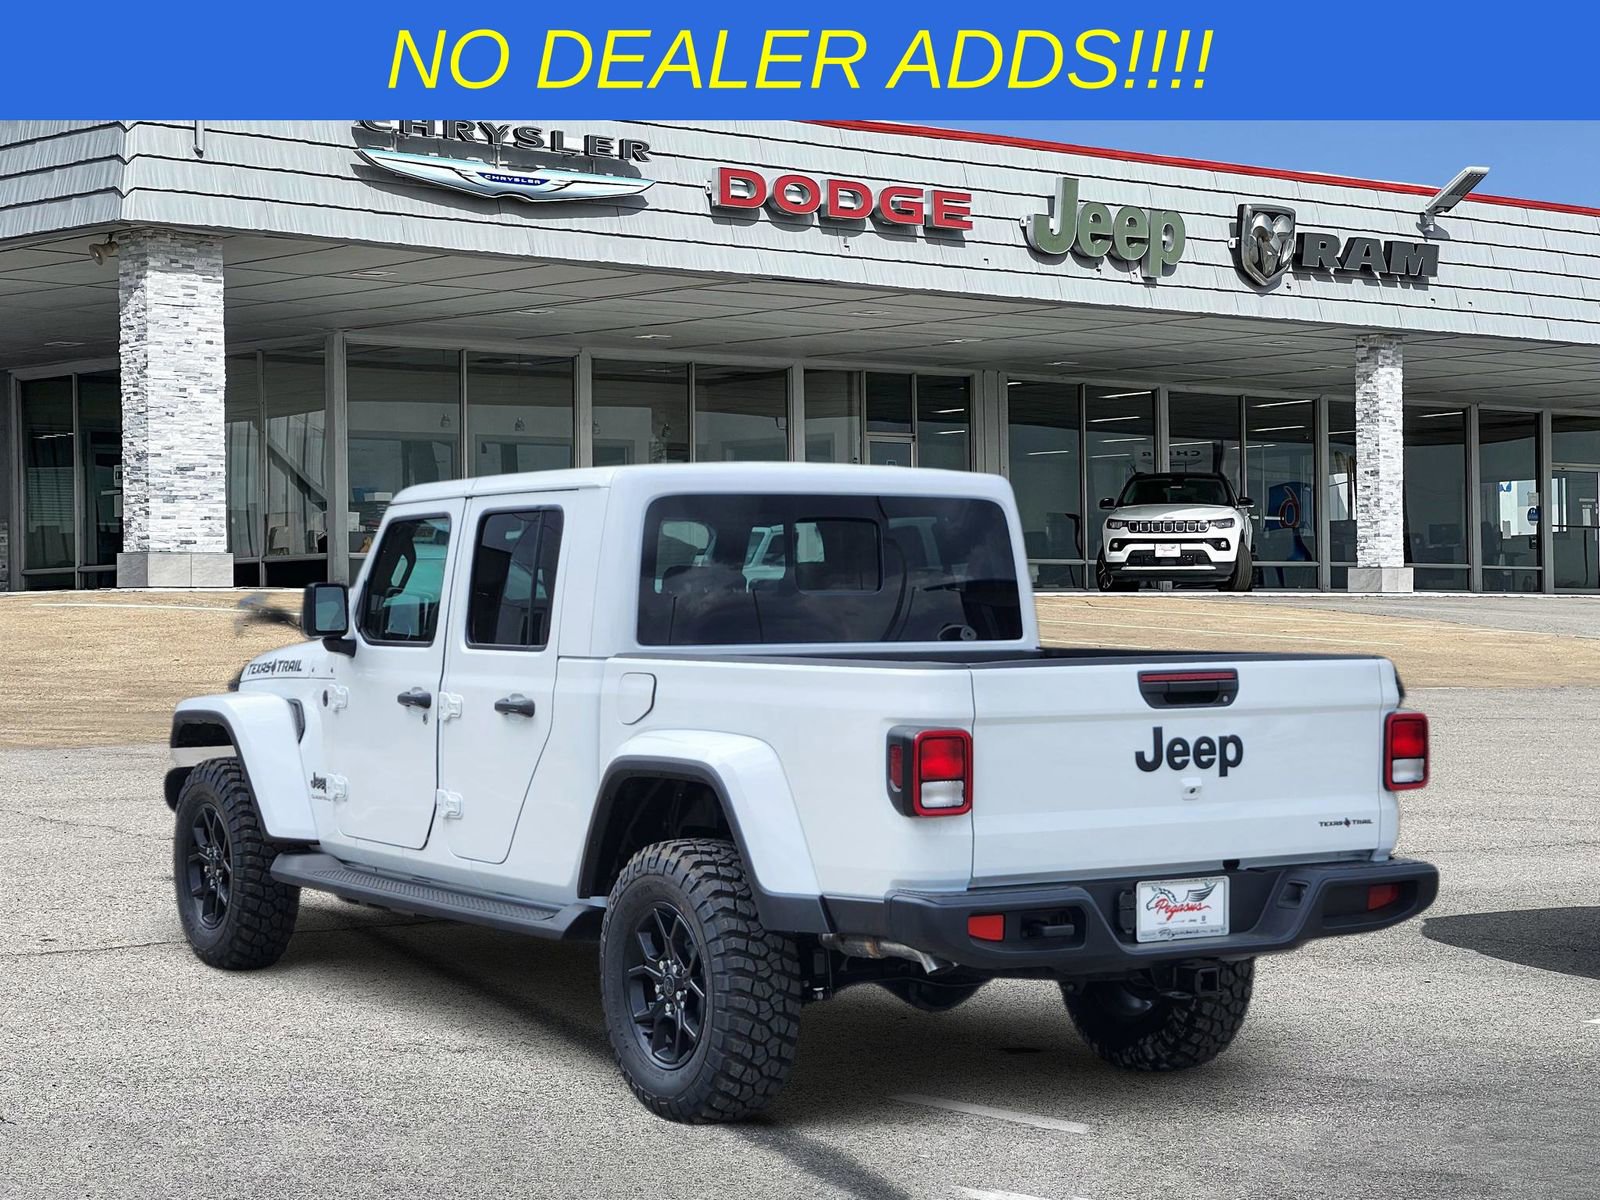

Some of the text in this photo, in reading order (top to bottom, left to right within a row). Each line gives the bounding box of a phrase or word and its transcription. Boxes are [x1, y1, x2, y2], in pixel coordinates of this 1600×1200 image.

[484, 174, 541, 185] CHRYSLER
[711, 166, 974, 230] DODGE
[1026, 176, 1186, 278] Jeep
[1299, 232, 1440, 277] RAM
[247, 659, 302, 675] TEXAS TRAIL
[1135, 726, 1244, 777] Jeep
[1155, 898, 1212, 921] Pegasus
